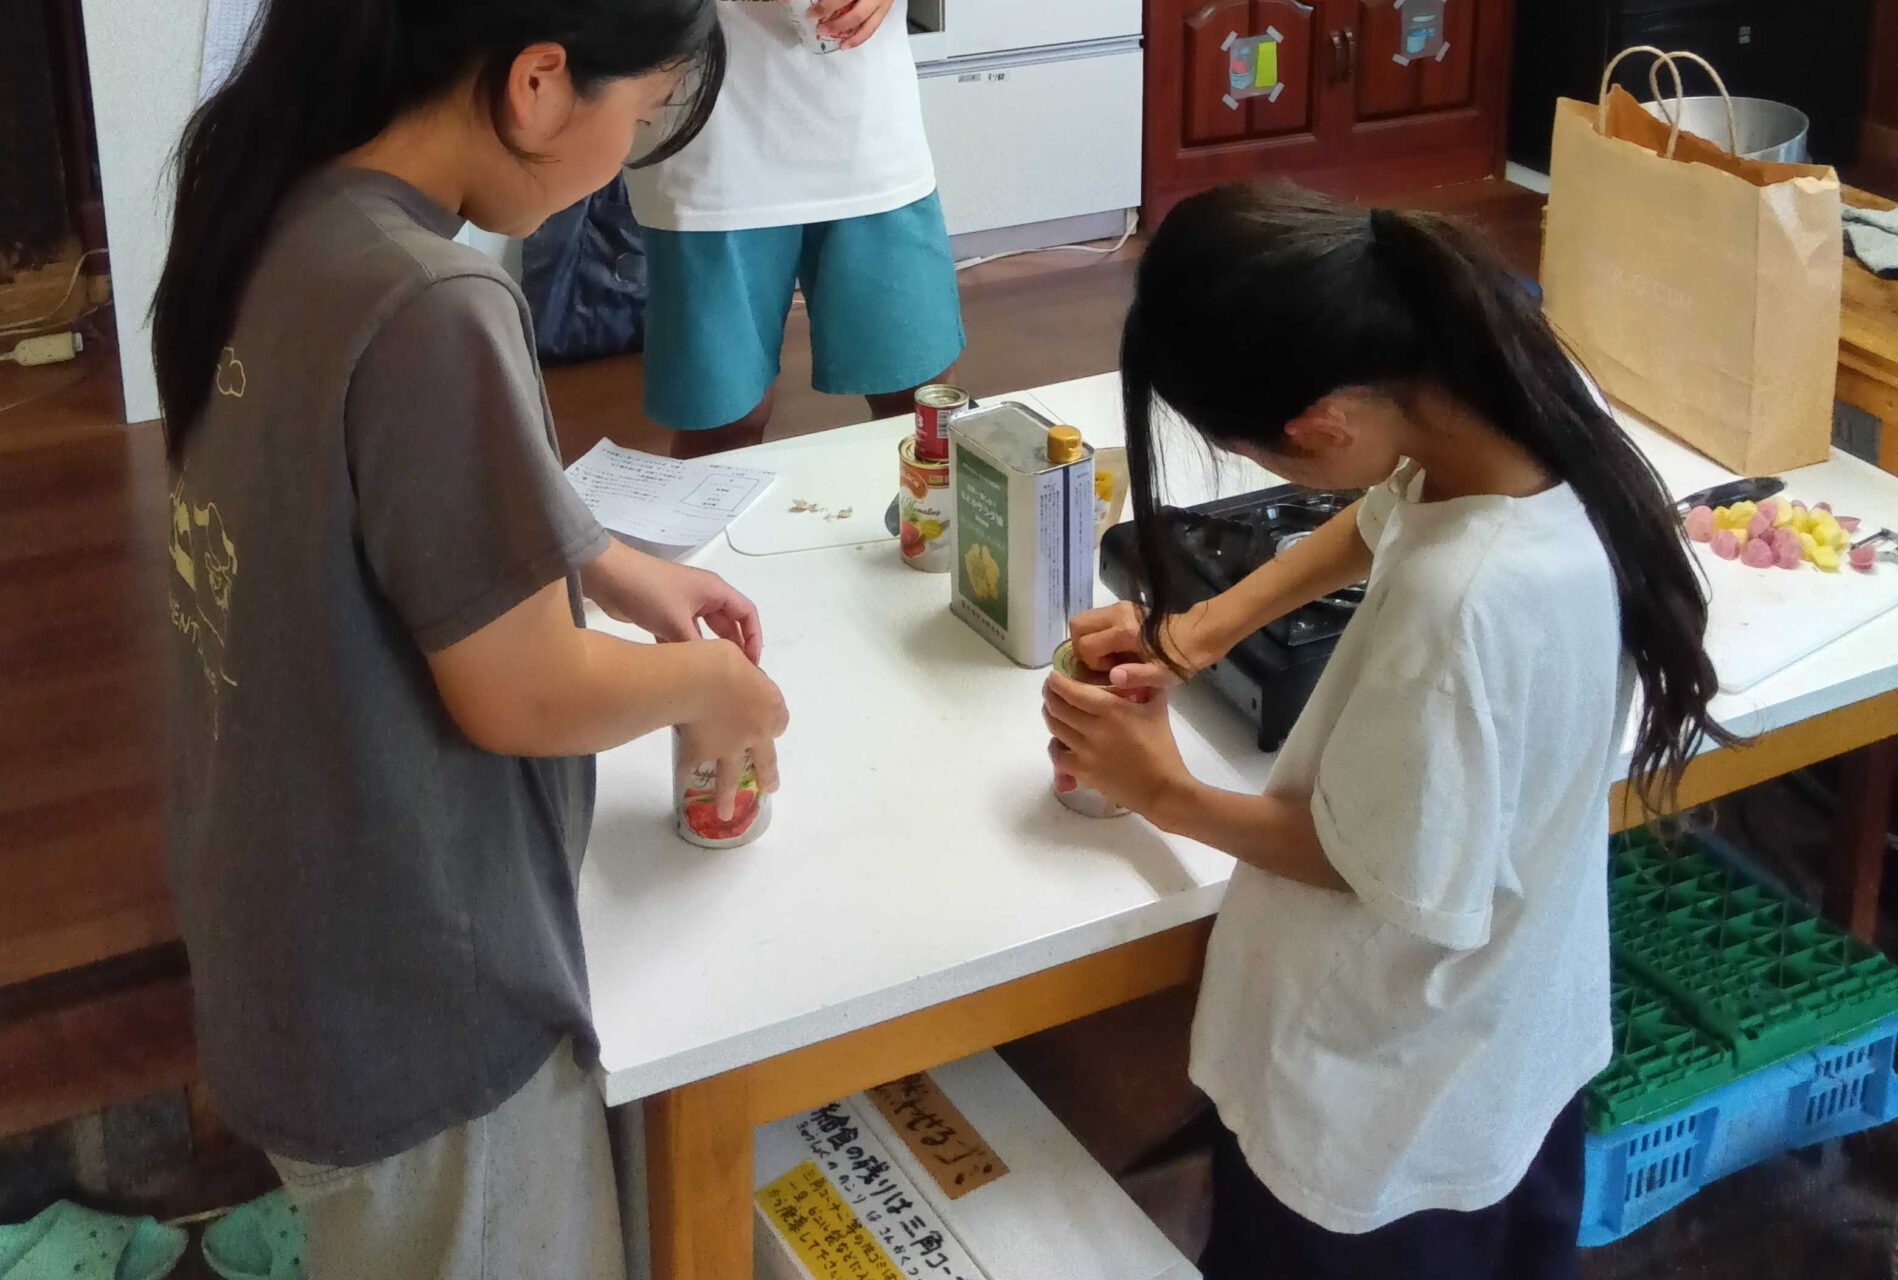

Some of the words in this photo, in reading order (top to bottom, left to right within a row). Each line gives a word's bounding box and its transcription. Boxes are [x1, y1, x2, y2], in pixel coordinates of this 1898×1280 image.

[810, 1102, 964, 1280] 給食の残りは三角コー
